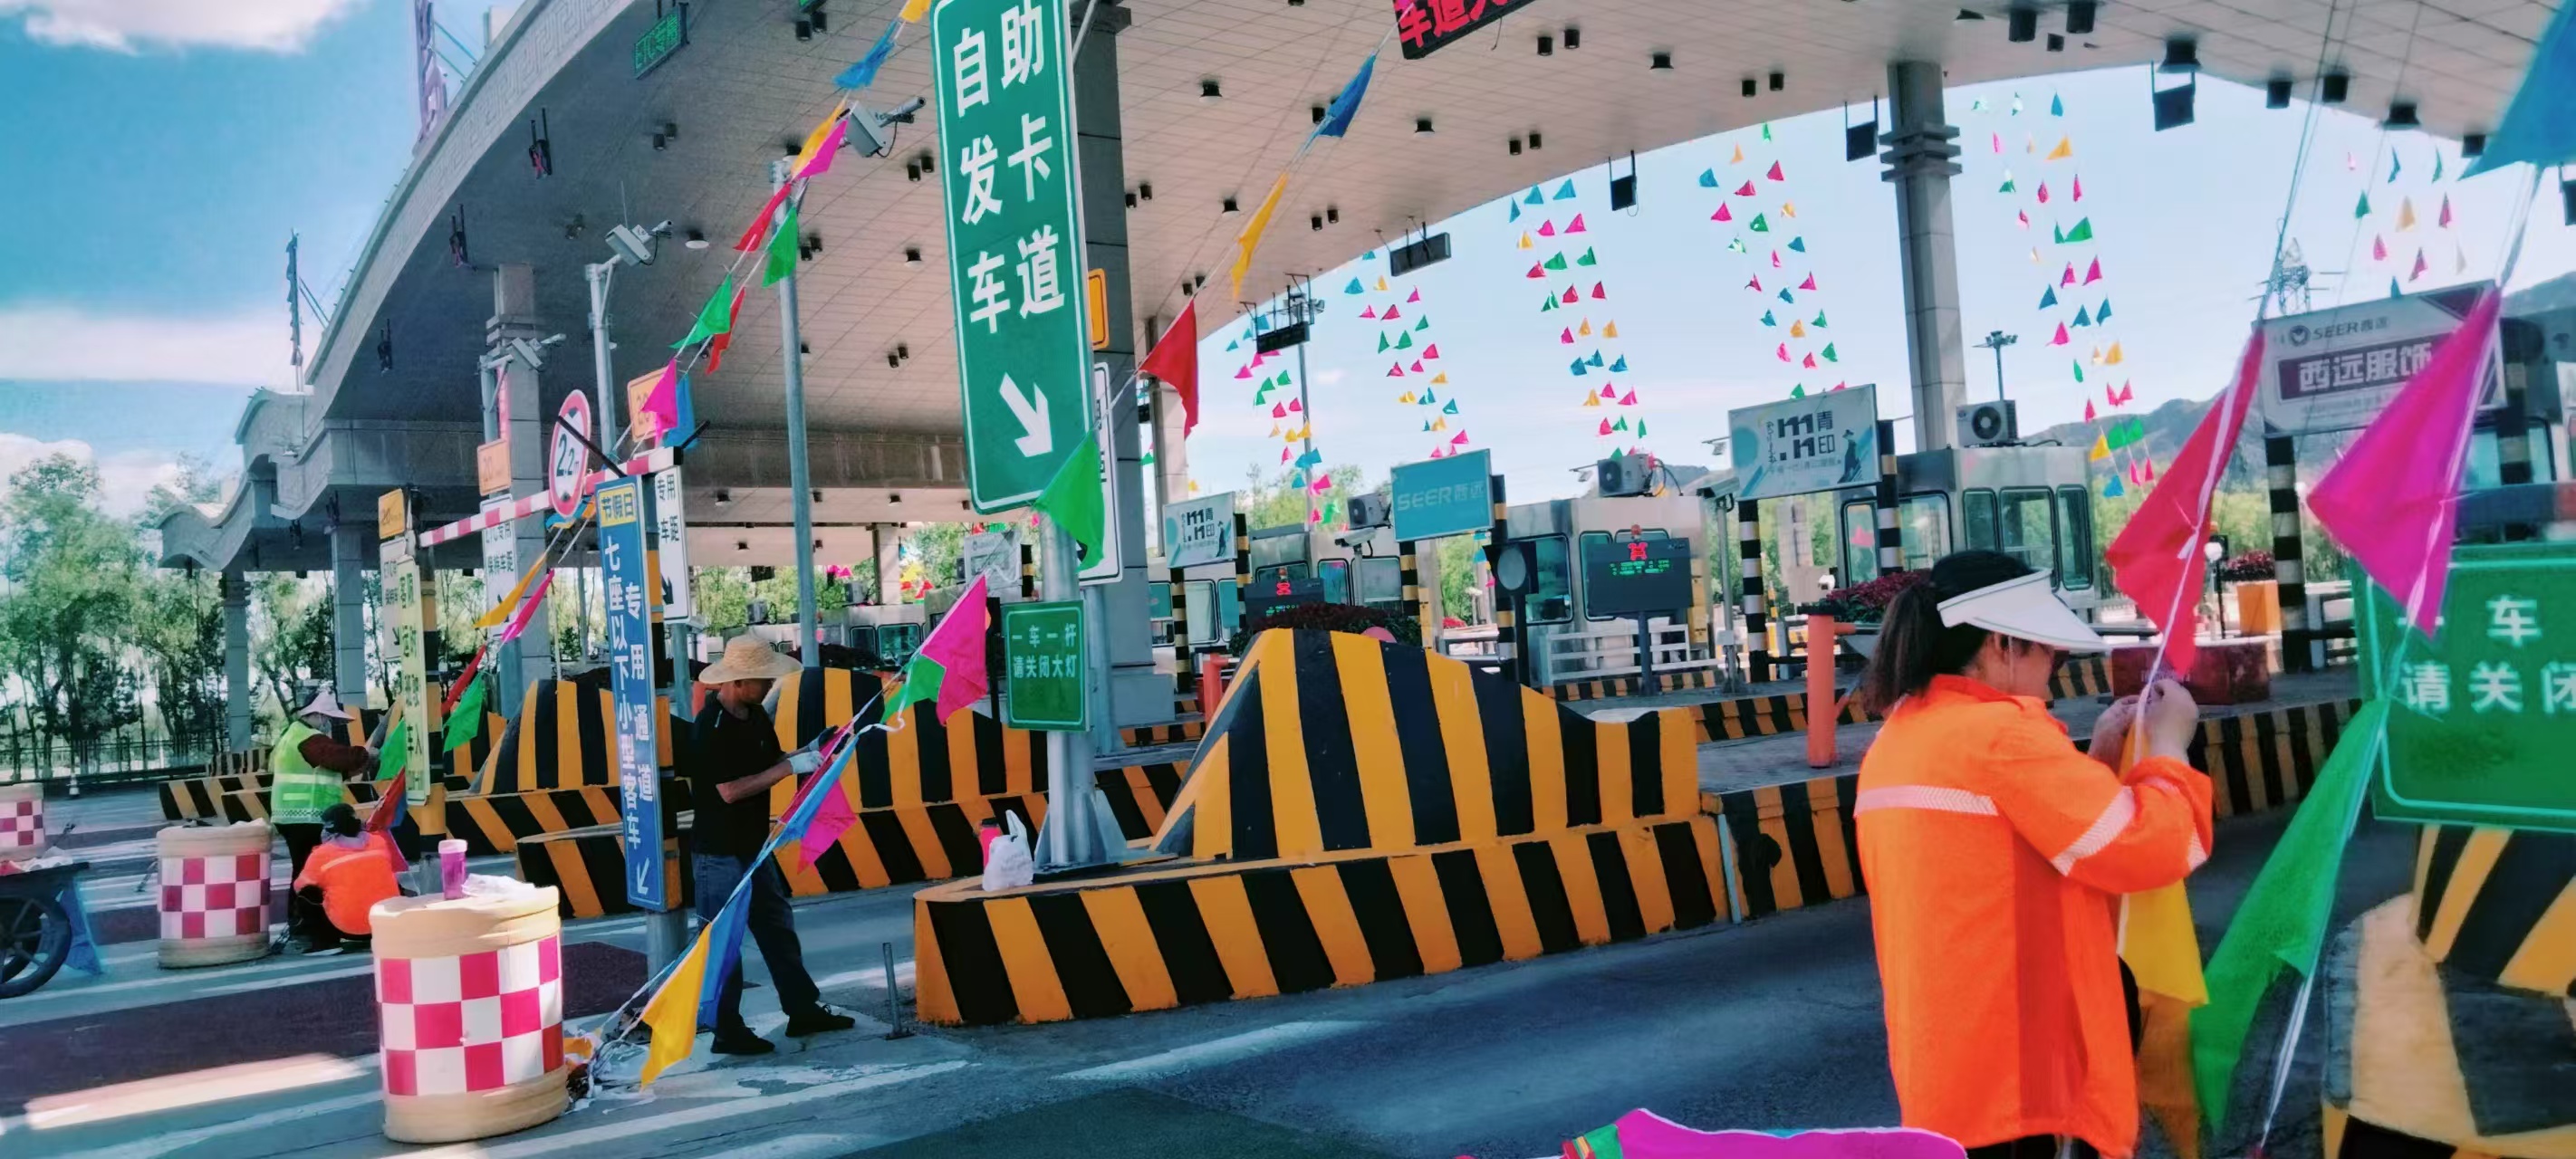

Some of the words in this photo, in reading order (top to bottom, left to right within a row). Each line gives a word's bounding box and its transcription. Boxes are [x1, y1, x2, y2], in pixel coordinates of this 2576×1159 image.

[953, 4, 1044, 117] 自助
[960, 112, 1053, 225] 发卡
[968, 225, 1064, 334] 车道
[601, 493, 634, 520] 节假日
[625, 581, 653, 802] 专用通道
[1013, 655, 1077, 678] 请关闭大灯
[2400, 661, 2576, 714] 请关闭
